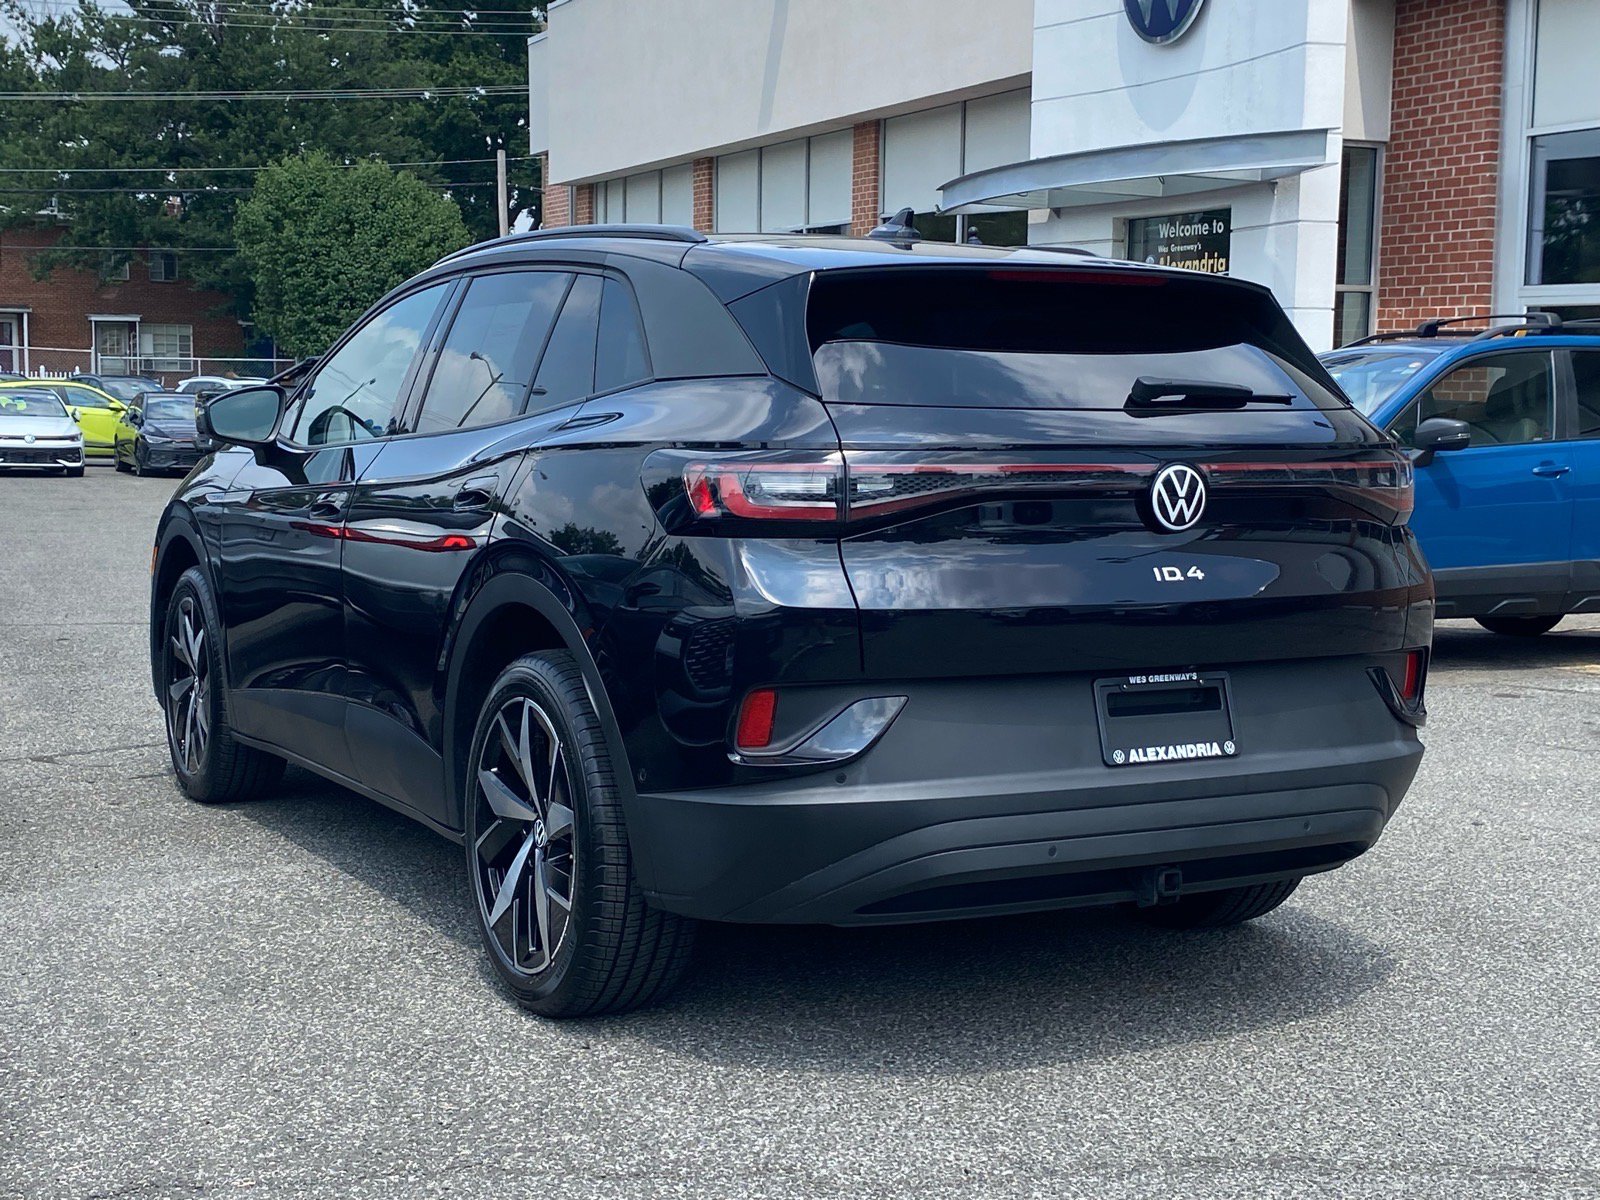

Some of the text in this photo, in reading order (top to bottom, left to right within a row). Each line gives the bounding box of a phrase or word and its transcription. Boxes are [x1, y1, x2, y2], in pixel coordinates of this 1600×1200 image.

[1159, 219, 1224, 238] Welcome to
[1170, 242, 1201, 253] Greenway's
[1153, 566, 1205, 581] ID.4
[1129, 672, 1198, 684] WES GREENWAY'S
[1129, 742, 1222, 763] ALEXANDRIA
